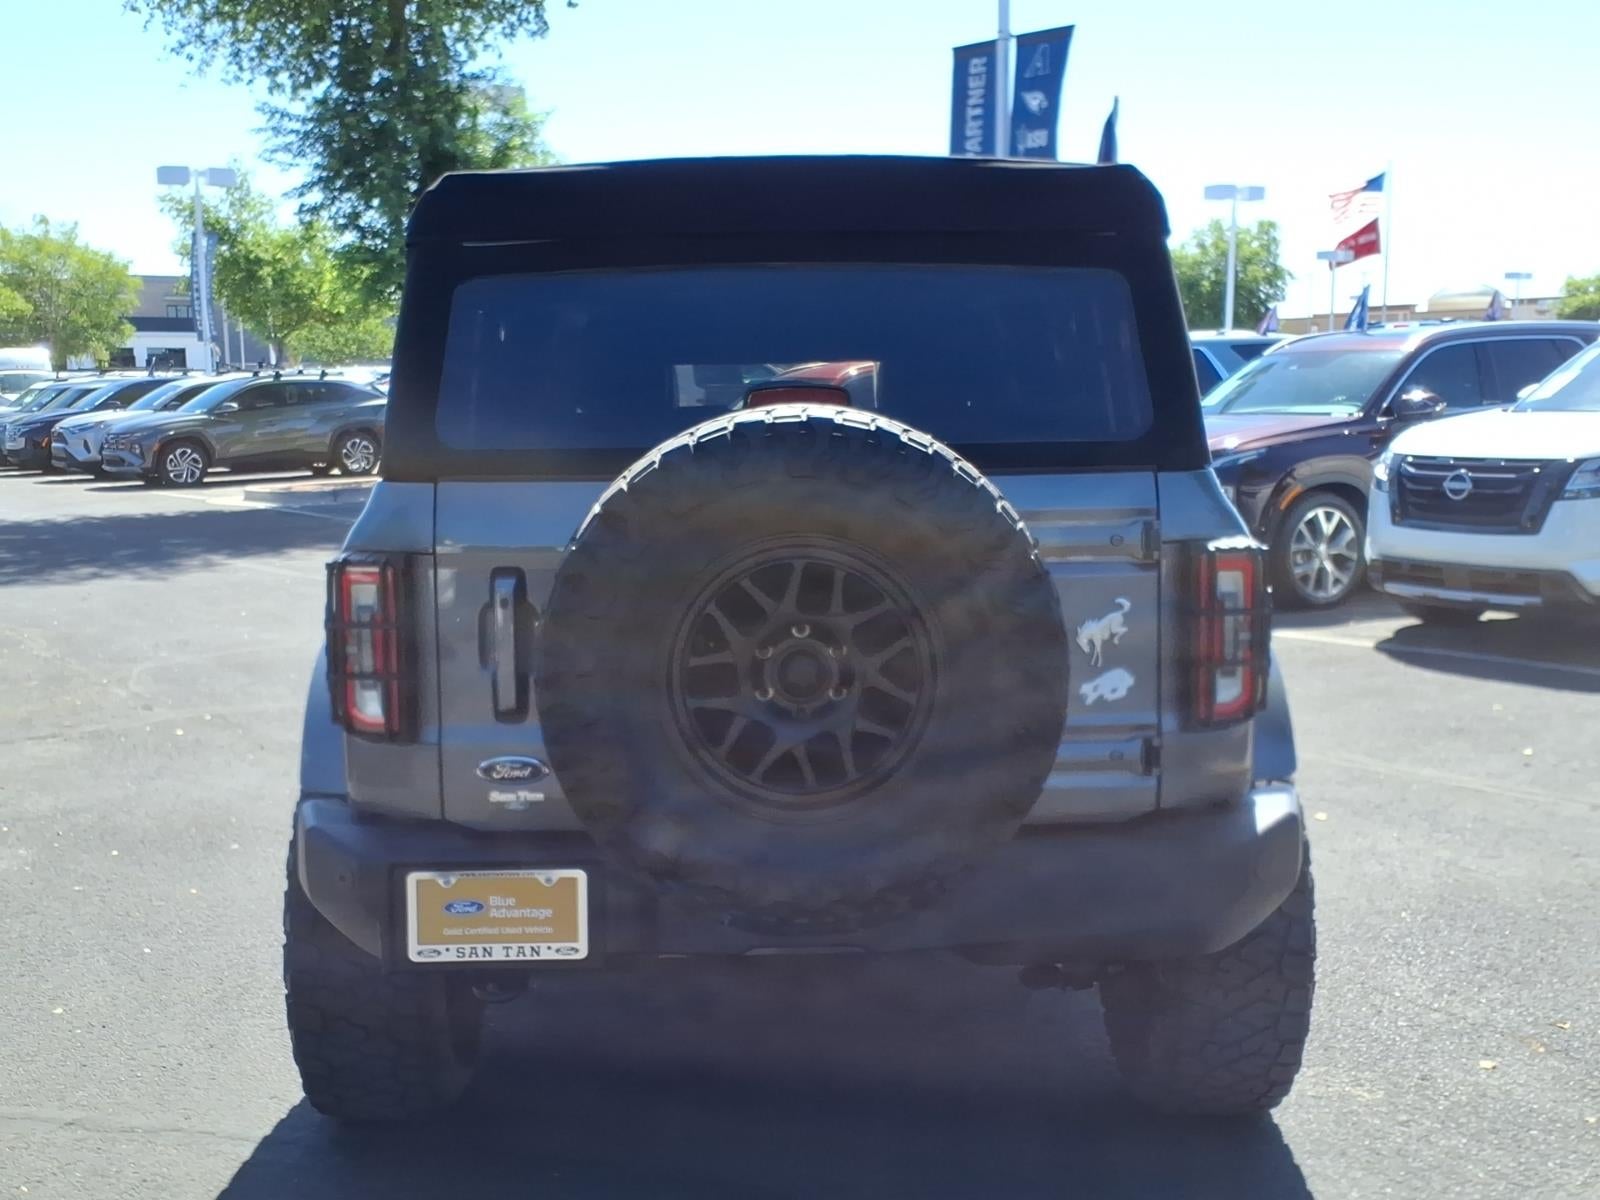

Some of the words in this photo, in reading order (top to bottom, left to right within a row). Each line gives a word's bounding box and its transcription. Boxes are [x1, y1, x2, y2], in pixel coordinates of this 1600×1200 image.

[450, 901, 480, 914] Ford
[489, 895, 516, 907] Blue
[489, 907, 553, 920] Advantage
[456, 946, 493, 959] SAN
[502, 945, 542, 958] TAN
